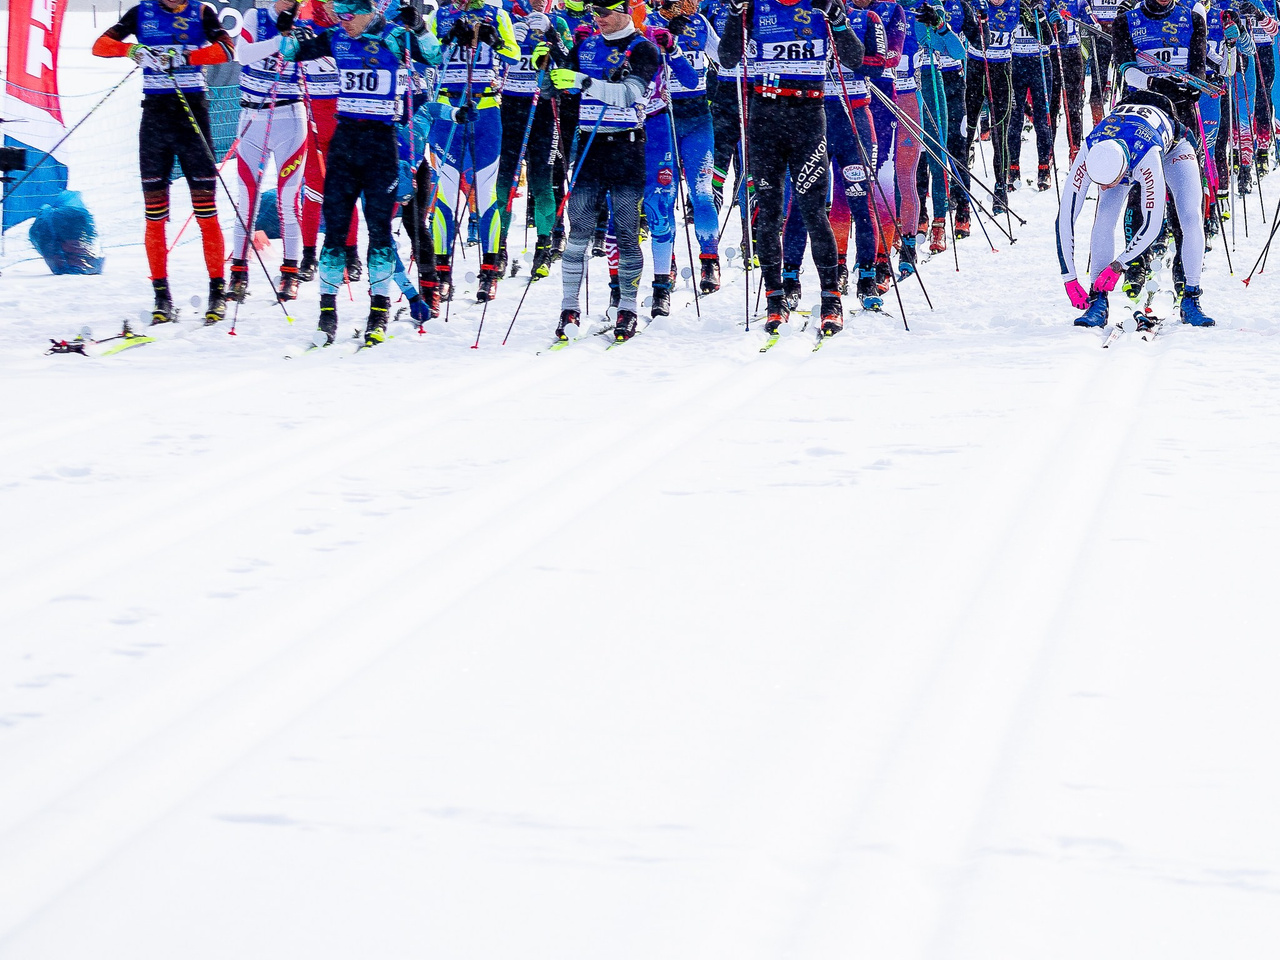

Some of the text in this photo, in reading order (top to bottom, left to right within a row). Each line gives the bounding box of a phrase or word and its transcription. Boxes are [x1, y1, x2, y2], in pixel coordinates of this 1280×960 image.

[794, 8, 812, 24] 25
[1162, 21, 1178, 34] 25
[875, 24, 887, 55] SATURN
[773, 43, 816, 60] 268
[345, 71, 379, 92] 310
[799, 166, 826, 194] team
